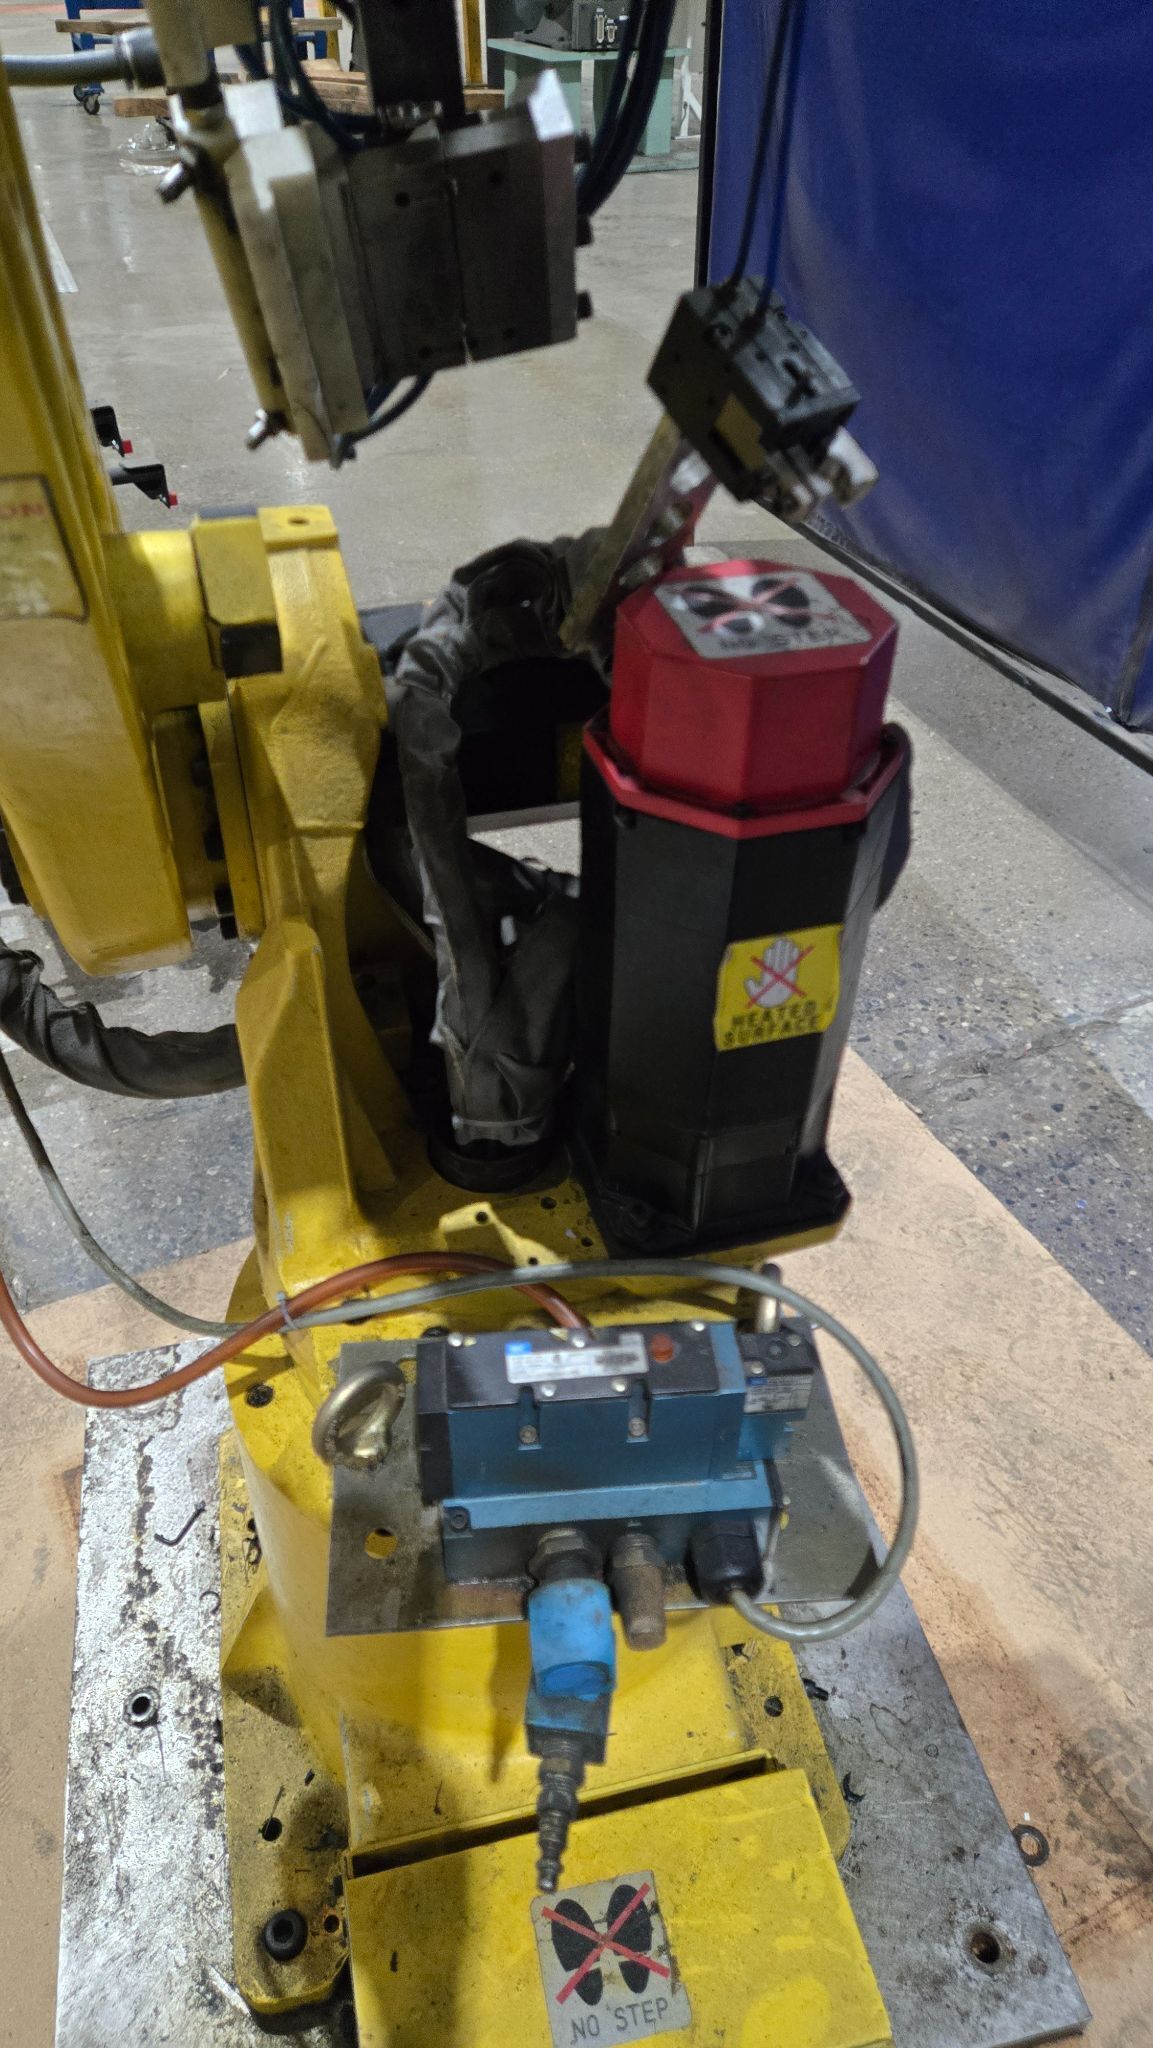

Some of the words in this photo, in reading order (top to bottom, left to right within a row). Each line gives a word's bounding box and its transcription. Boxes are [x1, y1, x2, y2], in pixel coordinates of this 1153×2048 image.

[731, 1000, 818, 1026] HEATED
[723, 1015, 819, 1046] SURFACE
[570, 2015, 600, 2045] NO
[614, 1997, 669, 2031] STEP
